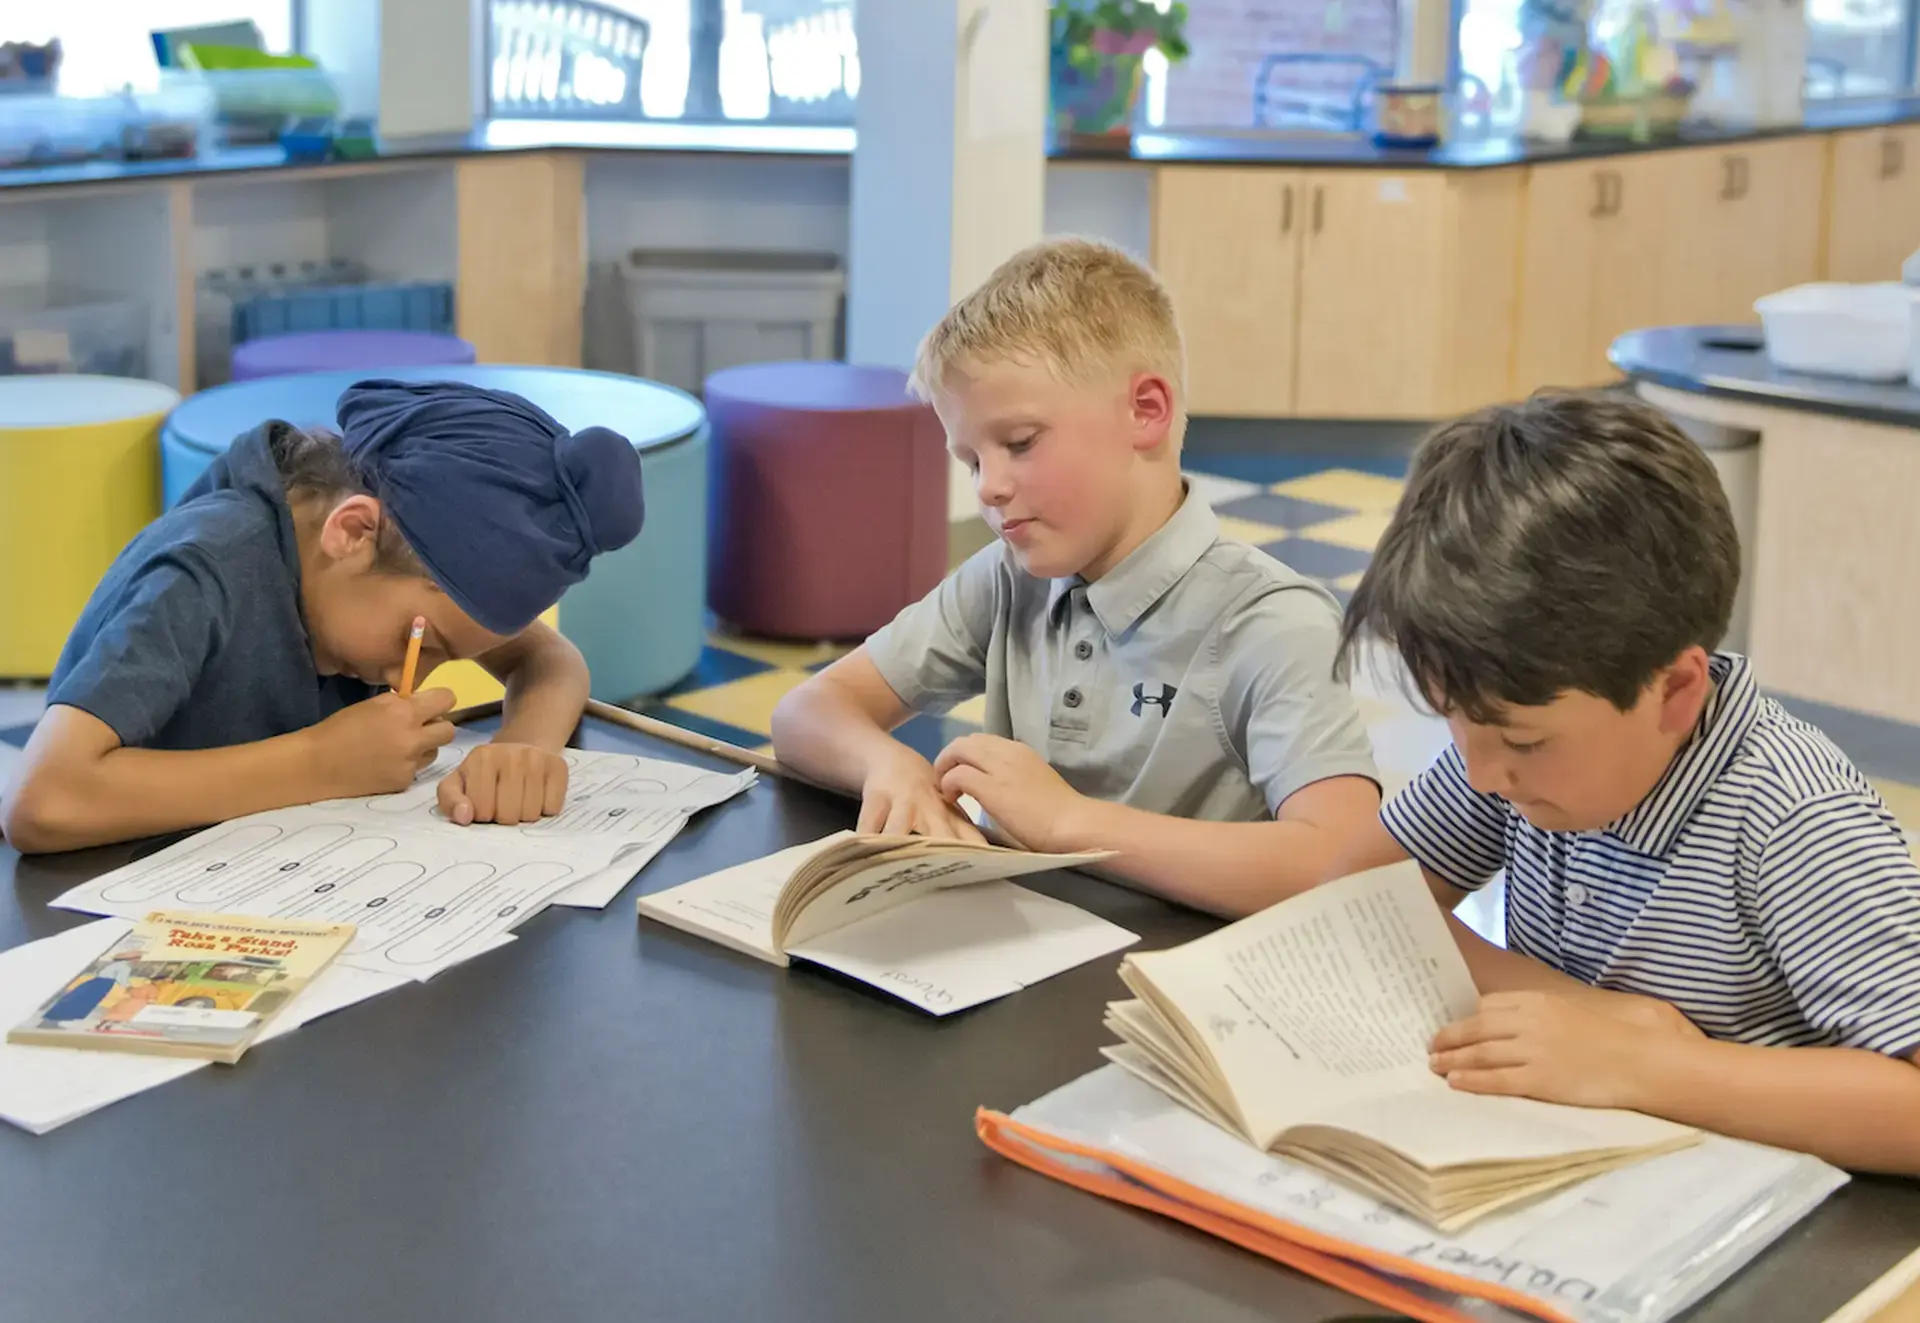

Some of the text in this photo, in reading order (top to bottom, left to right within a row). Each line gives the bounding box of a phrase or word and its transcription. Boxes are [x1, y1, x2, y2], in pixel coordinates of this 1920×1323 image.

[166, 938, 293, 957] Rosa Parks!
[168, 928, 299, 950] Take a Stand,
